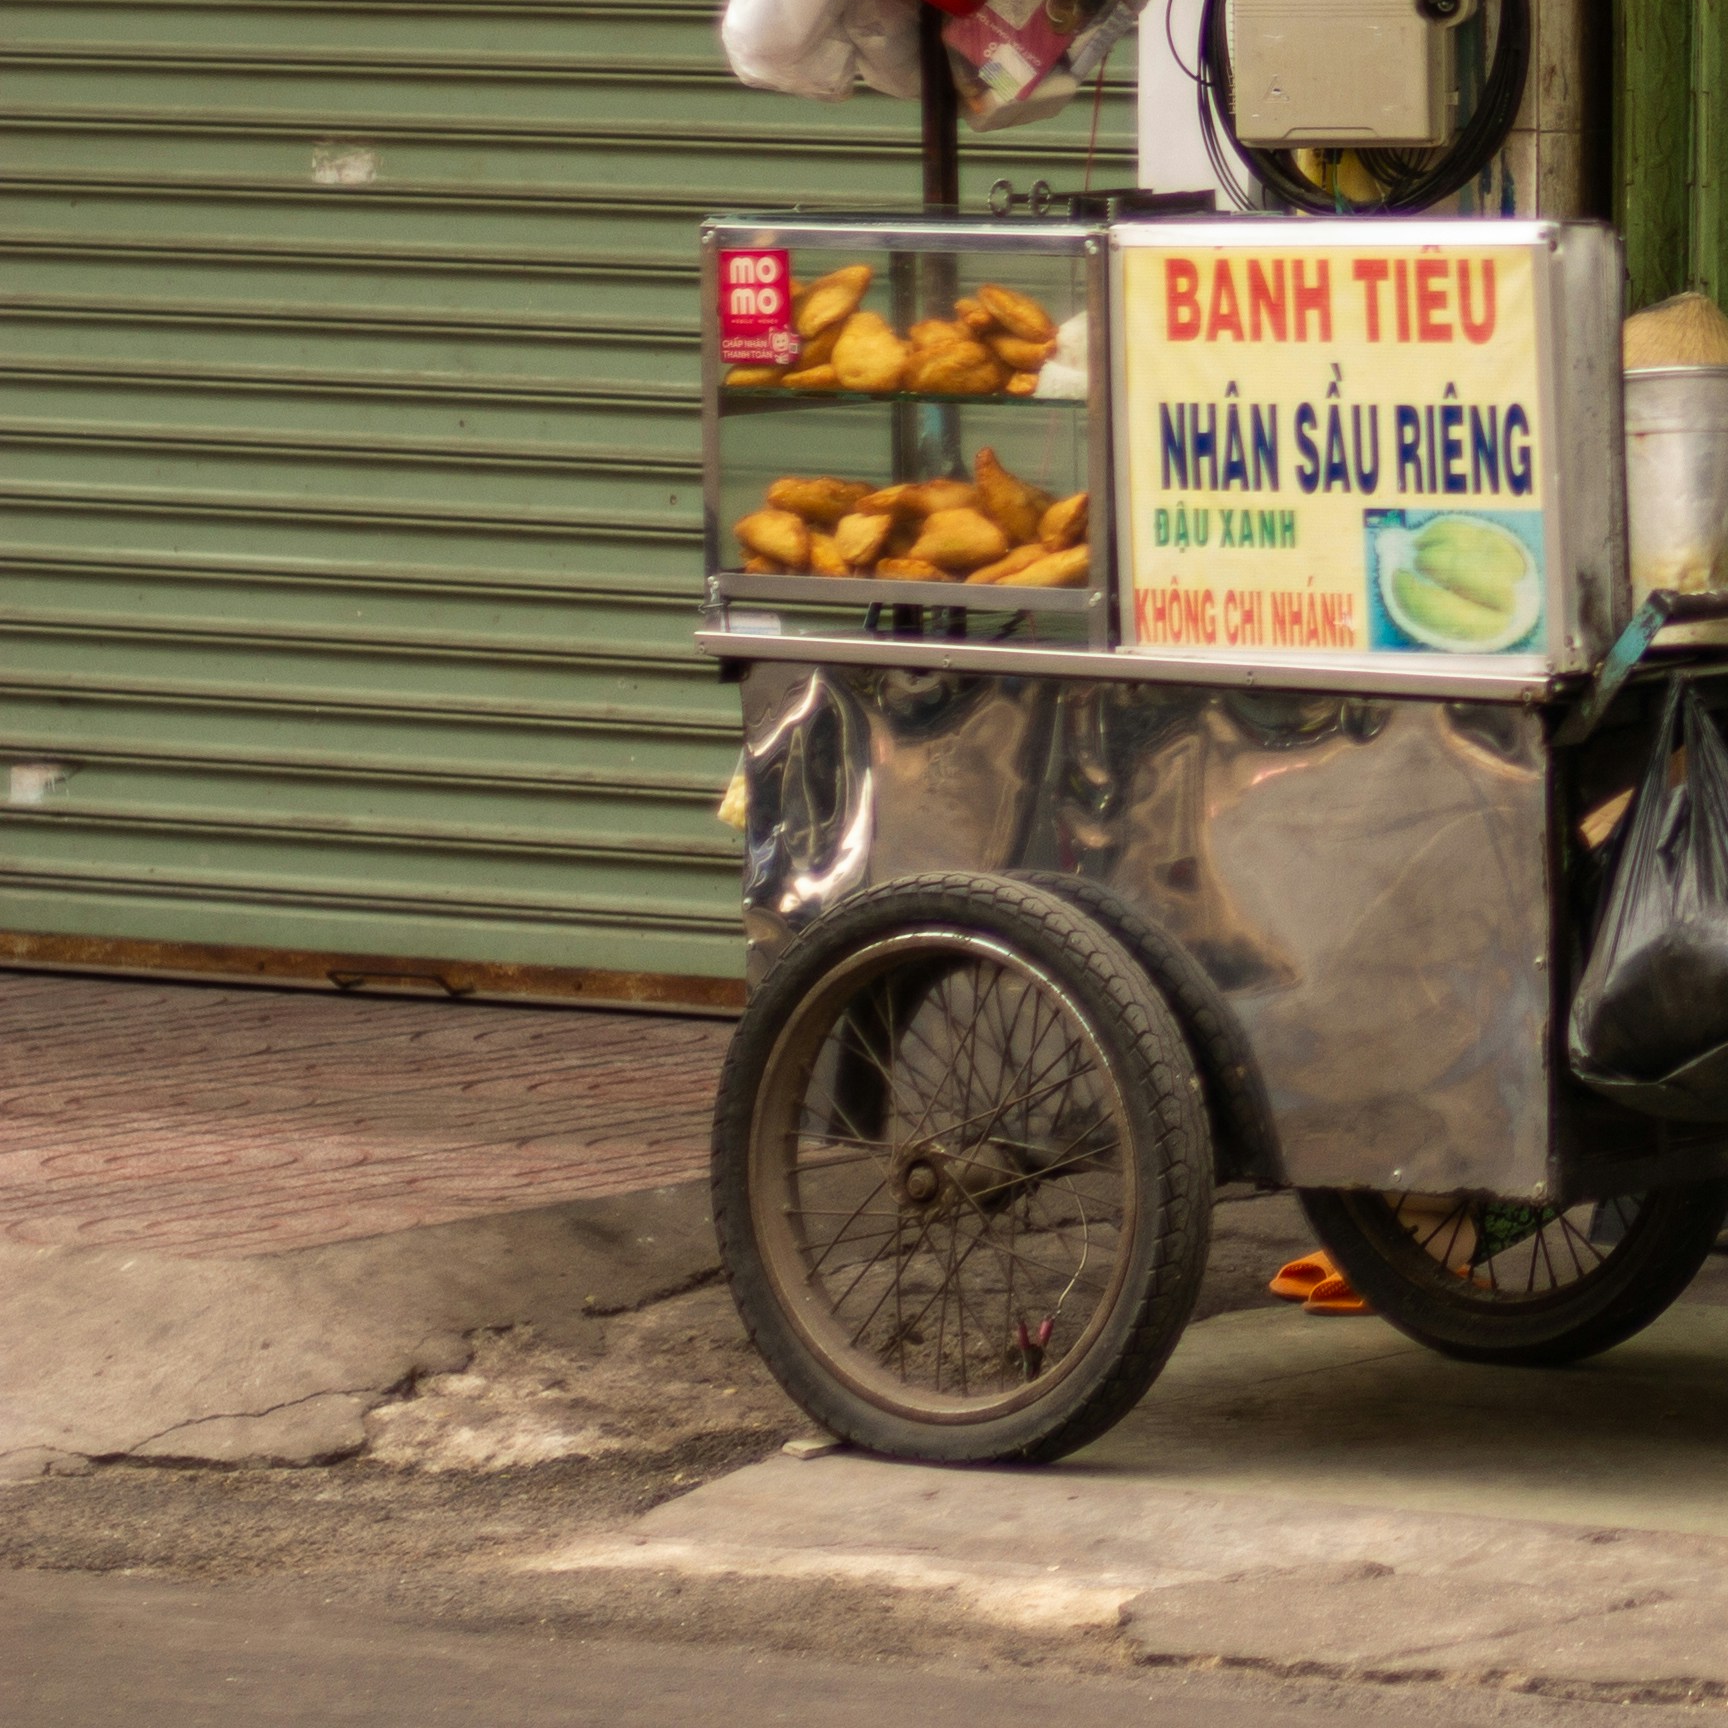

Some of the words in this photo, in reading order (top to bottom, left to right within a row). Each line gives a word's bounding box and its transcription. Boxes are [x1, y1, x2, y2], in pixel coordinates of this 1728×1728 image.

[1163, 245, 1334, 344] BÁNH
[1352, 244, 1498, 345] TIÊU
[1158, 380, 1281, 493] NHÂN
[1293, 362, 1381, 496] SẦU
[1394, 382, 1535, 497] RIÊNG
[1153, 500, 1210, 554] ĐẬU
[1219, 508, 1298, 549] XANH
[1134, 575, 1218, 645] KHÔNG
[1223, 588, 1264, 645] CHI
[1270, 575, 1355, 649] NHÁNH
